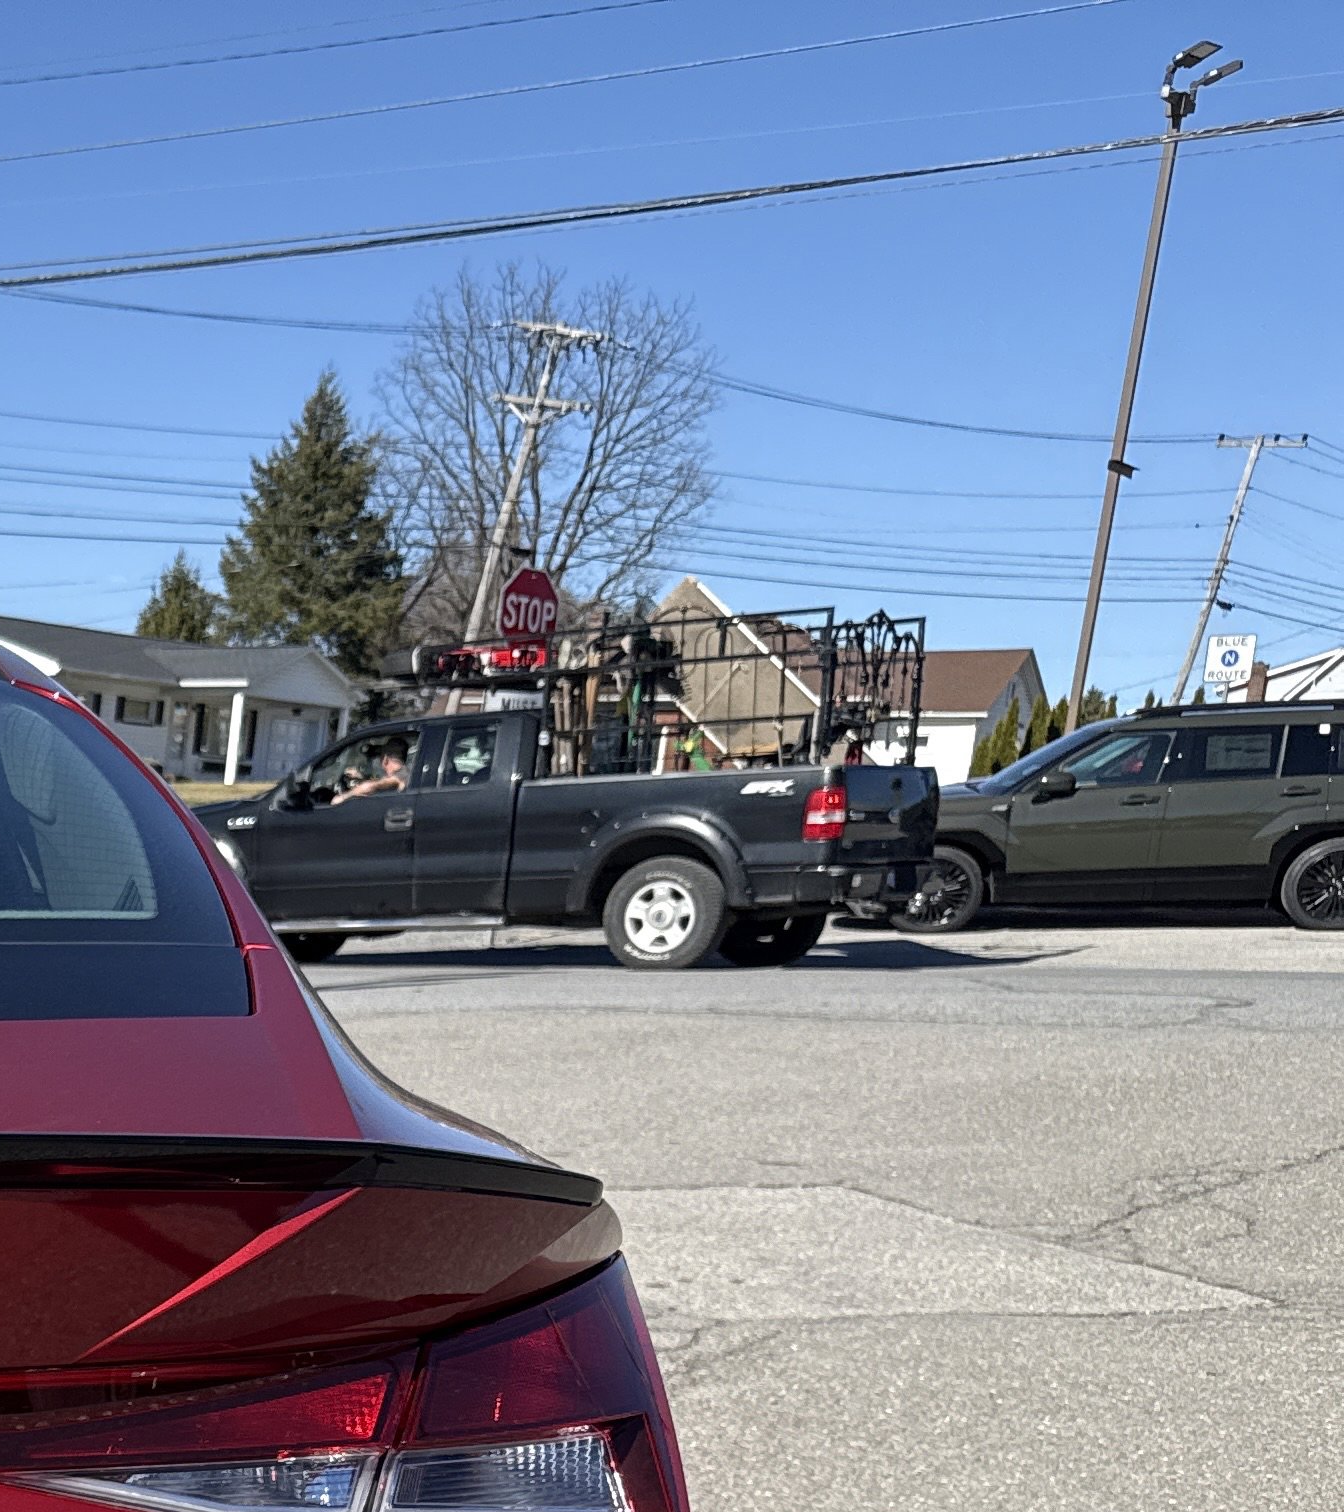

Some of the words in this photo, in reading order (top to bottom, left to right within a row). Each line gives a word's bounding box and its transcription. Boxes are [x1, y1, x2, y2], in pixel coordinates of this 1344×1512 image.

[503, 594, 556, 634] STOP
[1216, 637, 1249, 647] BLUE
[1224, 651, 1236, 665] N
[1207, 670, 1248, 681] ROUTE
